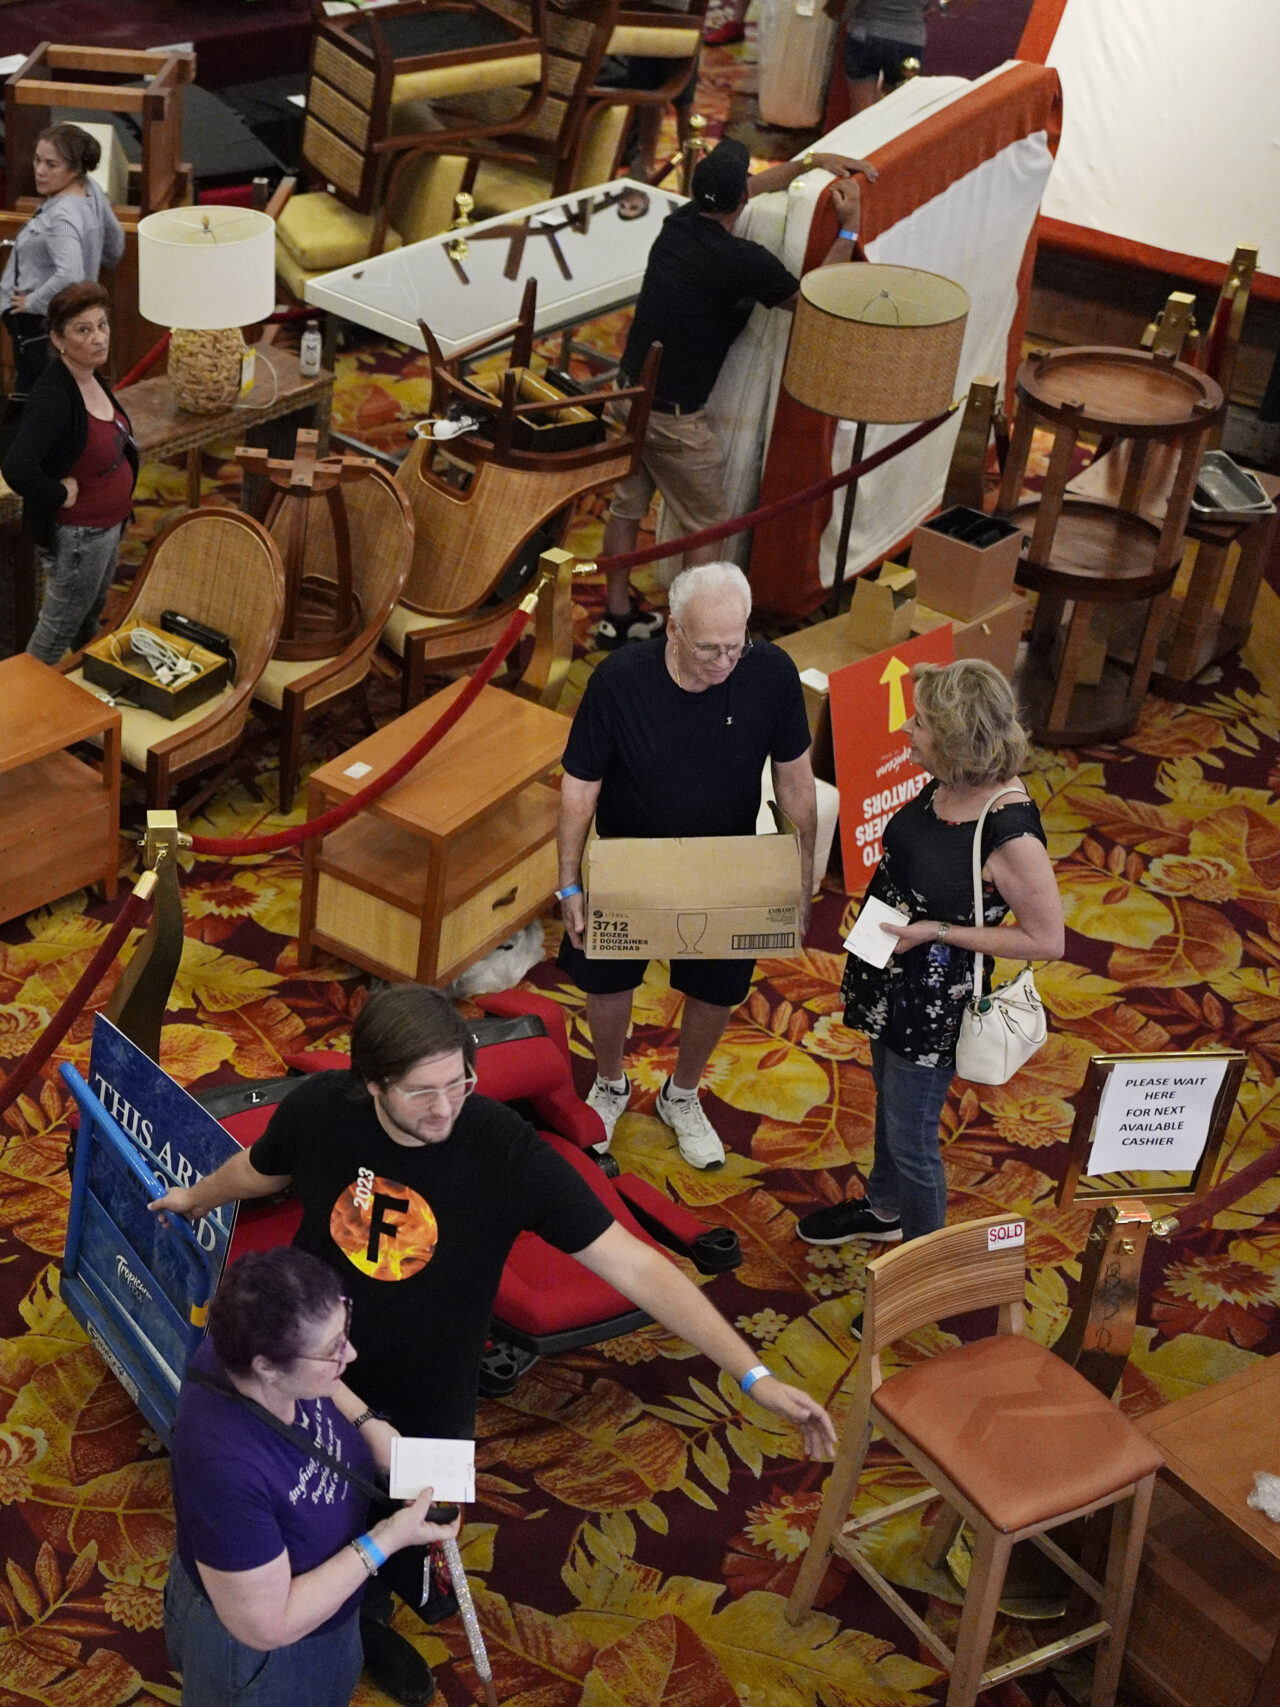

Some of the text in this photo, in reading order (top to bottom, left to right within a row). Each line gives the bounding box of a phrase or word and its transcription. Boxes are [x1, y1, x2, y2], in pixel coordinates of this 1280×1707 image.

[855, 807, 902, 847] ERS
[862, 841, 883, 867] TO
[592, 920, 629, 931] 3712
[1125, 1077, 1207, 1088] PLEASE WAIT
[1144, 1091, 1176, 1101] HERE
[1125, 1105, 1186, 1118] FOR NEXT
[1118, 1121, 1184, 1132] AVAILABLE
[95, 1073, 154, 1149] THIS
[157, 1140, 224, 1226] ARA
[1121, 1137, 1174, 1146] CASHIER
[353, 1167, 375, 1211] 2023
[366, 1193, 410, 1264] F
[989, 1224, 1023, 1242] SOLD
[312, 1465, 331, 1505] Everythi
